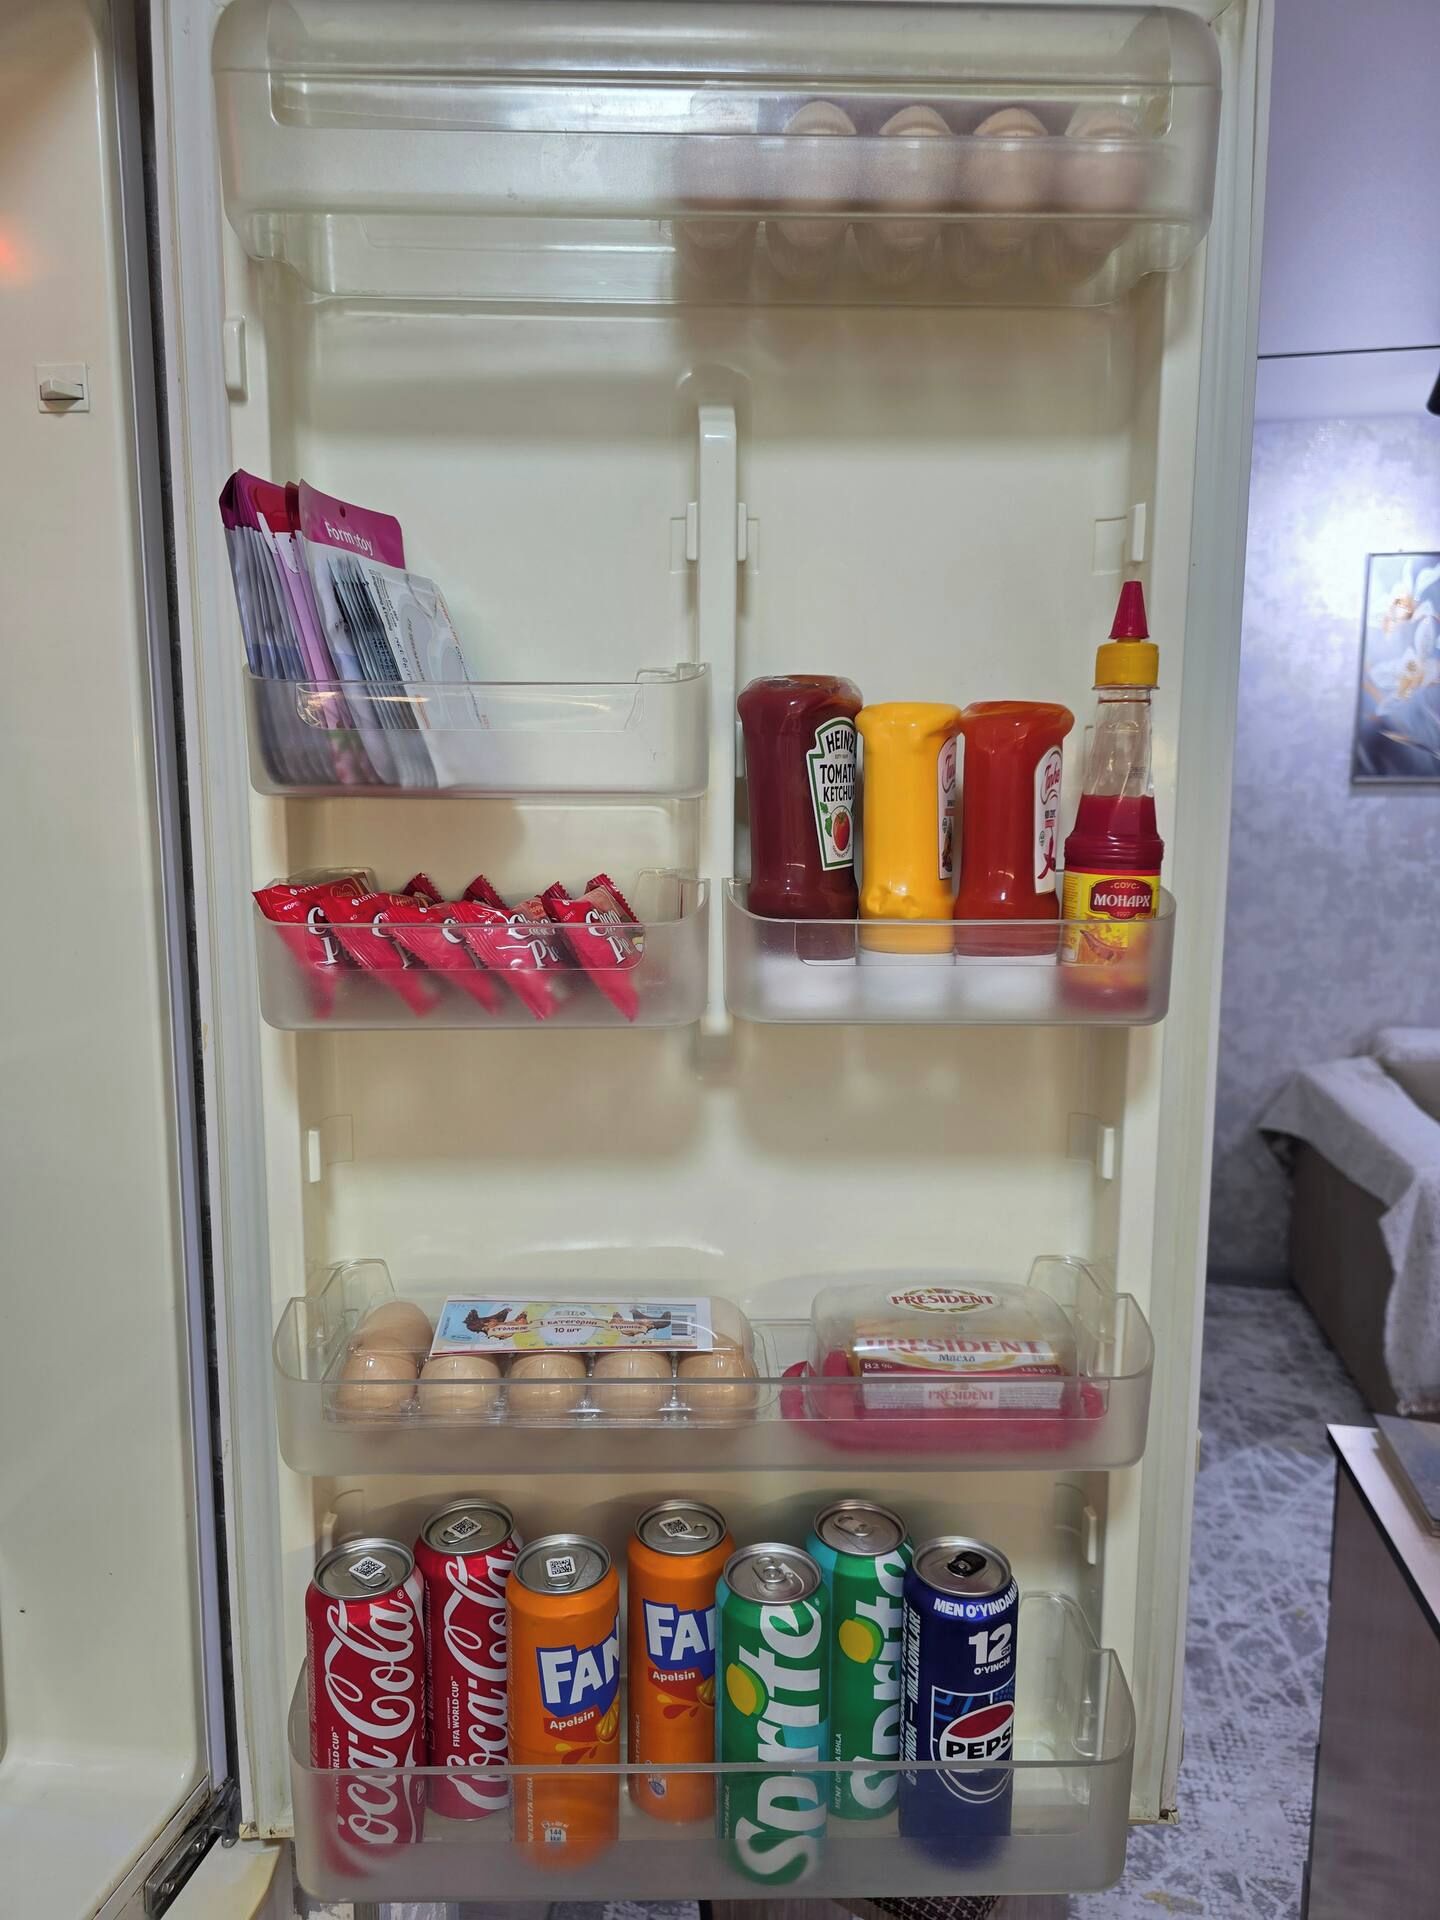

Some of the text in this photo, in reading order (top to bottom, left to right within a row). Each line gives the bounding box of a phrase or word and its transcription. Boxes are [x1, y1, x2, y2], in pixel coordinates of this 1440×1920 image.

[825, 730, 854, 754] HEINZ
[823, 785, 855, 802] KETCHU
[1093, 893, 1152, 908] МОНАРХ
[933, 1597, 964, 1617] MEN
[968, 1622, 1012, 1665] 12
[906, 1608, 921, 1704] MILLIONLAR!
[652, 1670, 696, 1683] Apelsin
[451, 1698, 460, 1729] WORLD
[550, 1710, 595, 1731] Apelsin
[452, 1730, 460, 1748] FIFA
[735, 1599, 827, 1882] Sprite
[332, 1750, 340, 1769] RLD
